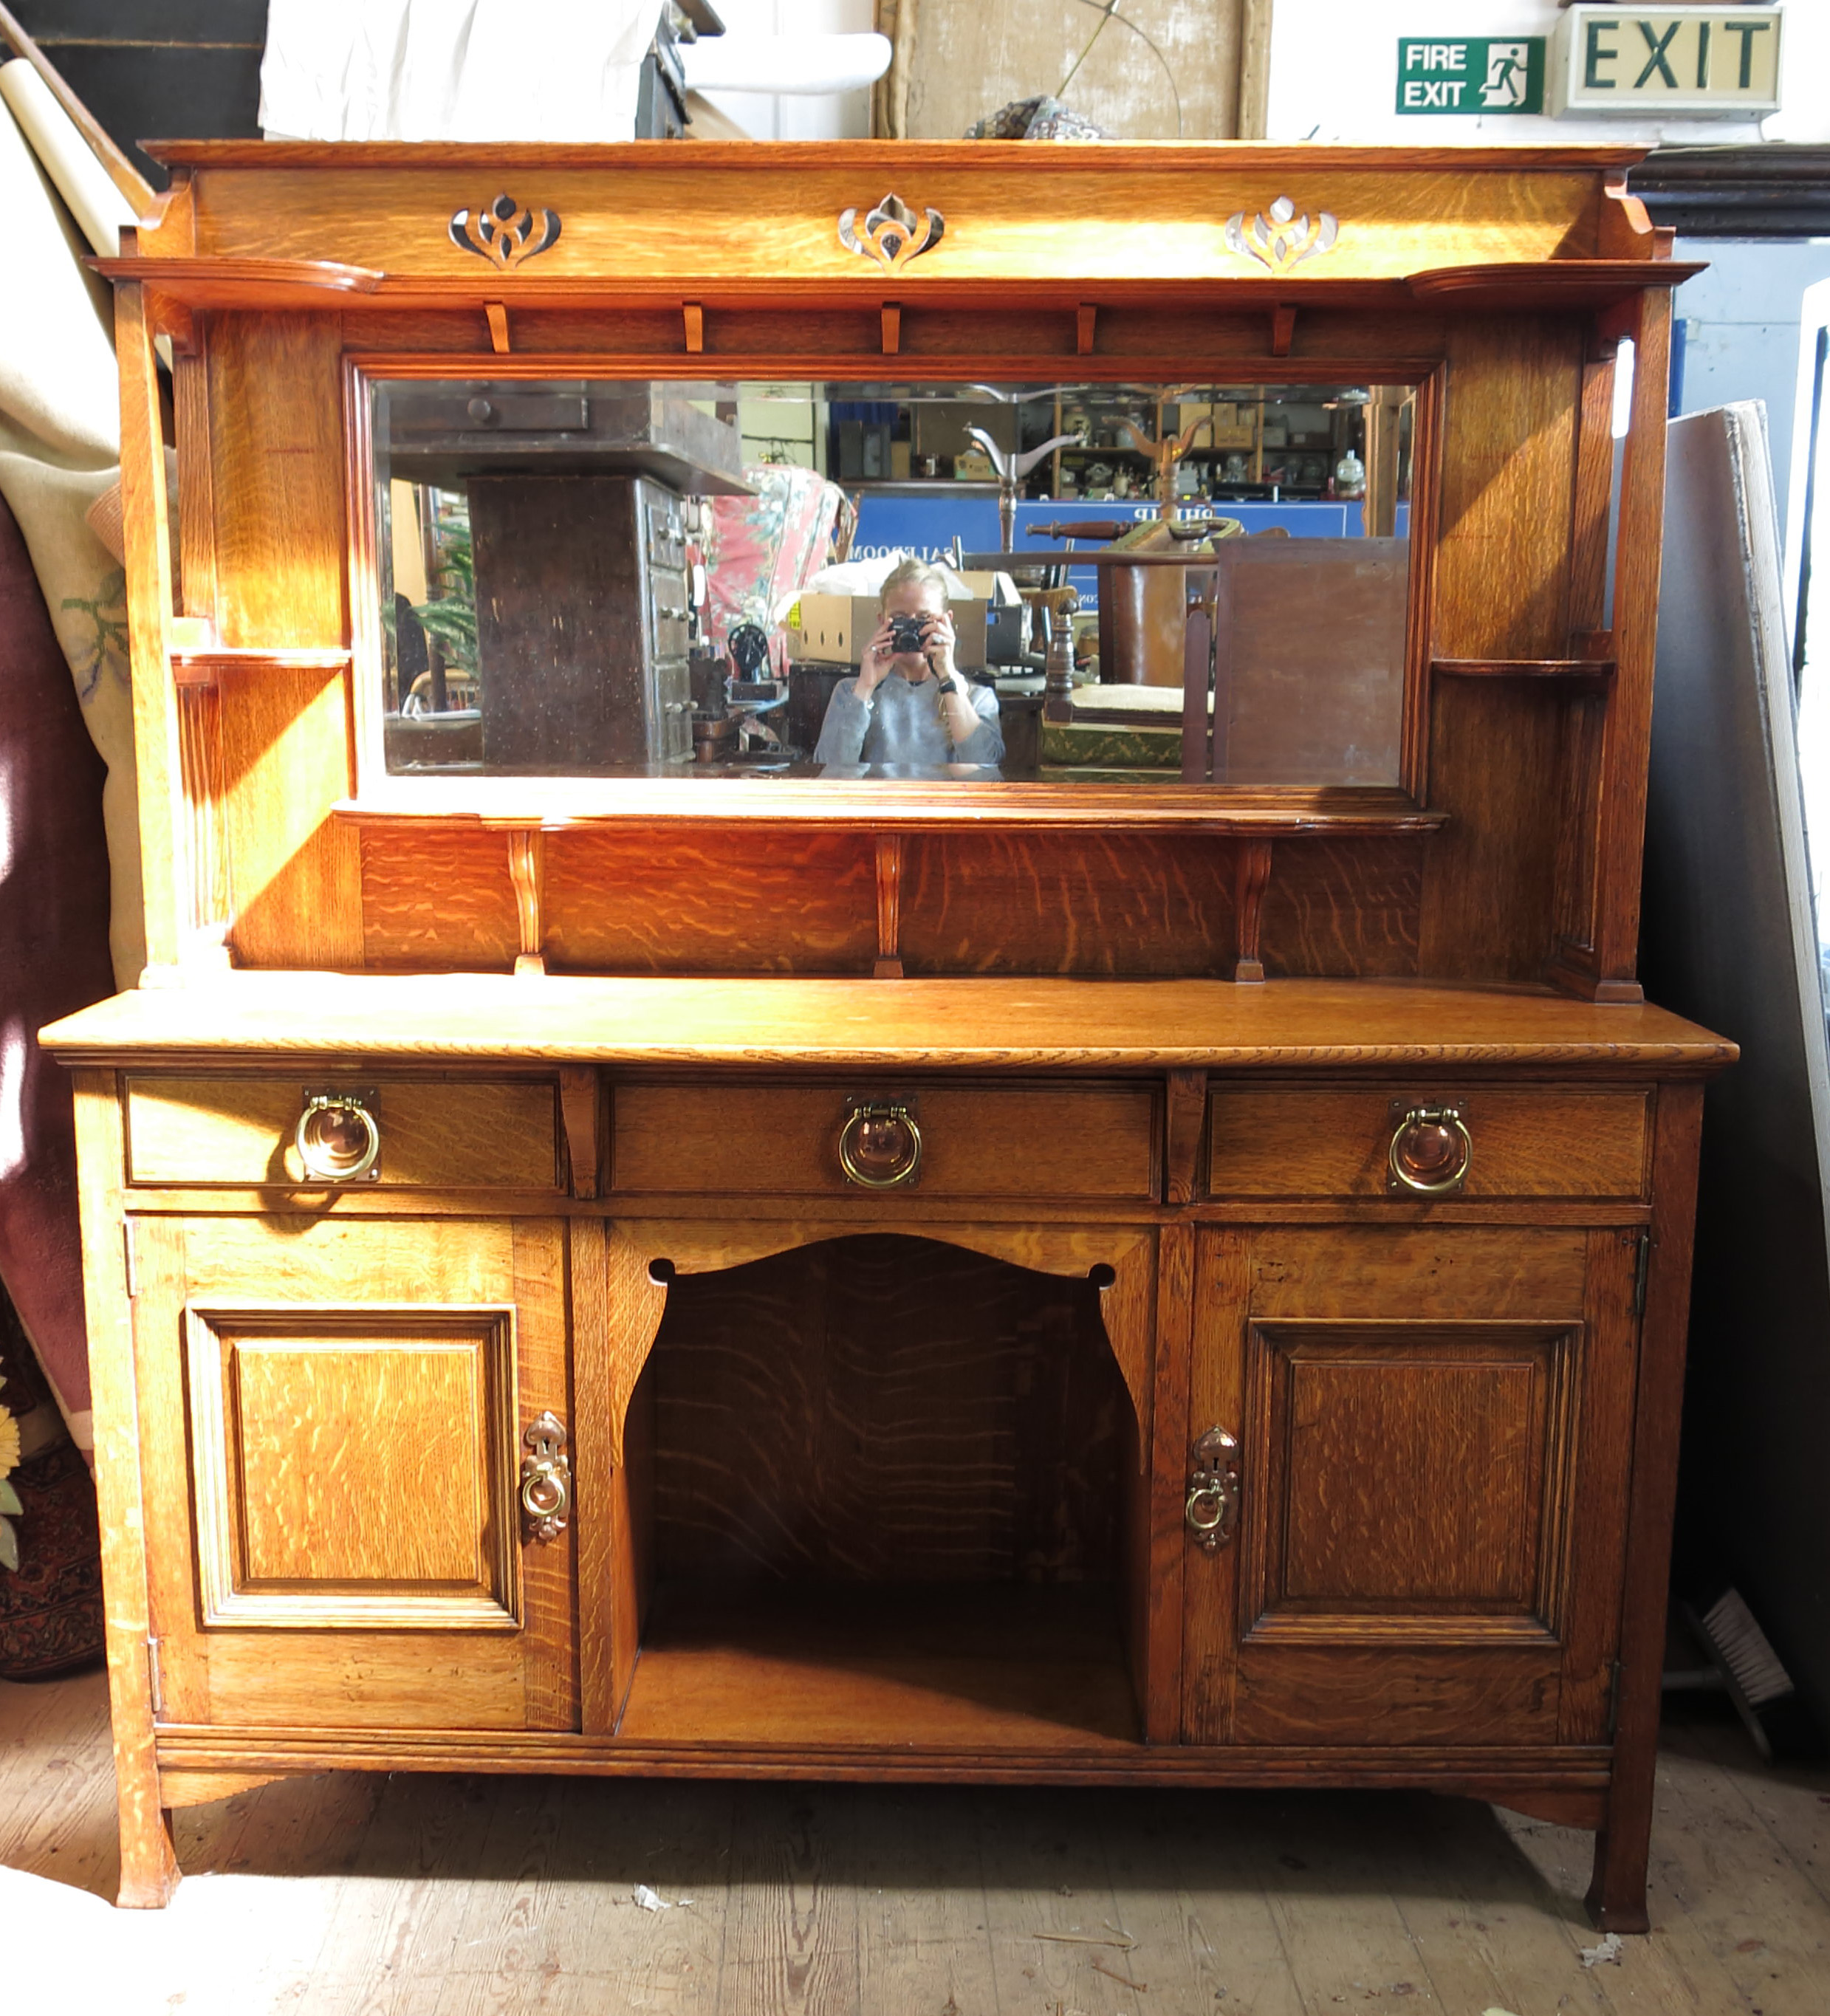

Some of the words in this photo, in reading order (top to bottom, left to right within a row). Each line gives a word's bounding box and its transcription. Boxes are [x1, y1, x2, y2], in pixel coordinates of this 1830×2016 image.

[1405, 44, 1467, 71] FIRE
[1584, 21, 1772, 89] EXIT
[1405, 82, 1467, 106] EXIT
